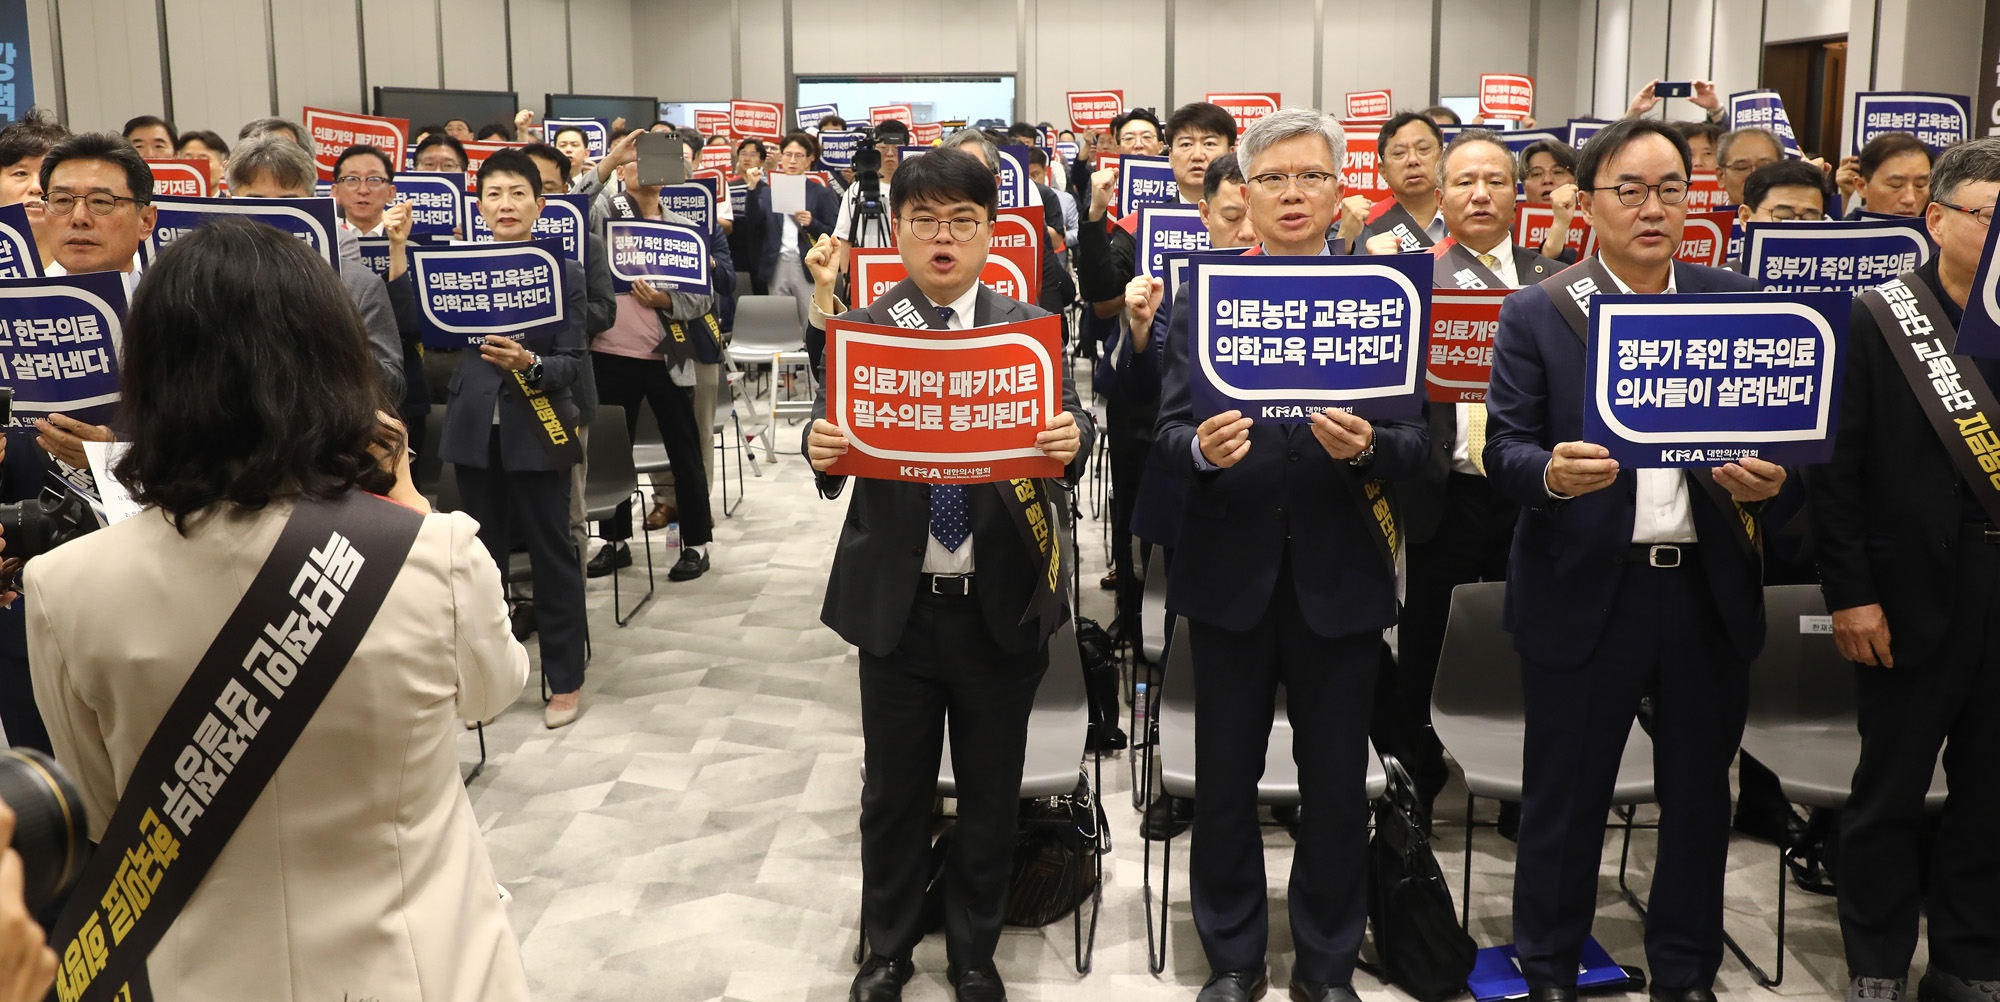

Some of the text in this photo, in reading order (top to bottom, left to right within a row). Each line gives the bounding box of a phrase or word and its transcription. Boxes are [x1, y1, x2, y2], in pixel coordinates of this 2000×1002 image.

[1867, 112, 1960, 130] 의료농단 교육농단
[314, 126, 395, 148] 의료개악 패키지로
[408, 192, 453, 208] 교육농단
[1132, 178, 1164, 198] 정부가
[1166, 179, 1179, 198] 죽
[673, 196, 706, 209] 한국의료
[411, 210, 454, 225] 무너진다
[615, 235, 698, 255] 정부가 죽인 한국의료
[1153, 230, 1211, 250] 의료농단
[615, 252, 699, 270] 의사들이 살려낸다
[1765, 252, 1916, 281] 정부가 죽인 한국의료
[429, 265, 549, 291] 의료농단 교육농단
[433, 287, 551, 313] 의학교육 무너진다
[1215, 297, 1404, 330] 의료농단 교육농단
[13, 314, 102, 347] 한국의료
[1215, 334, 1402, 366] 의학교육 무너진다
[1617, 337, 1816, 371] 정부가 죽인 한국의료
[11, 347, 110, 381] 살려낸다
[1911, 338, 1978, 413] 교육농단
[853, 362, 1038, 399] 의료개악 패키지로
[1615, 375, 1814, 408] 의사들이 살려낸다
[1460, 391, 1486, 400] KM
[853, 398, 1039, 432] 필수의료 붕괴된다
[1261, 405, 1304, 418] KMA
[1661, 449, 1705, 462] KMA
[900, 465, 991, 479] KMA 대한의사협회
[242, 531, 366, 700] 독단적인
[160, 677, 271, 836] 갑질정부
[100, 806, 181, 947] 한국의료
